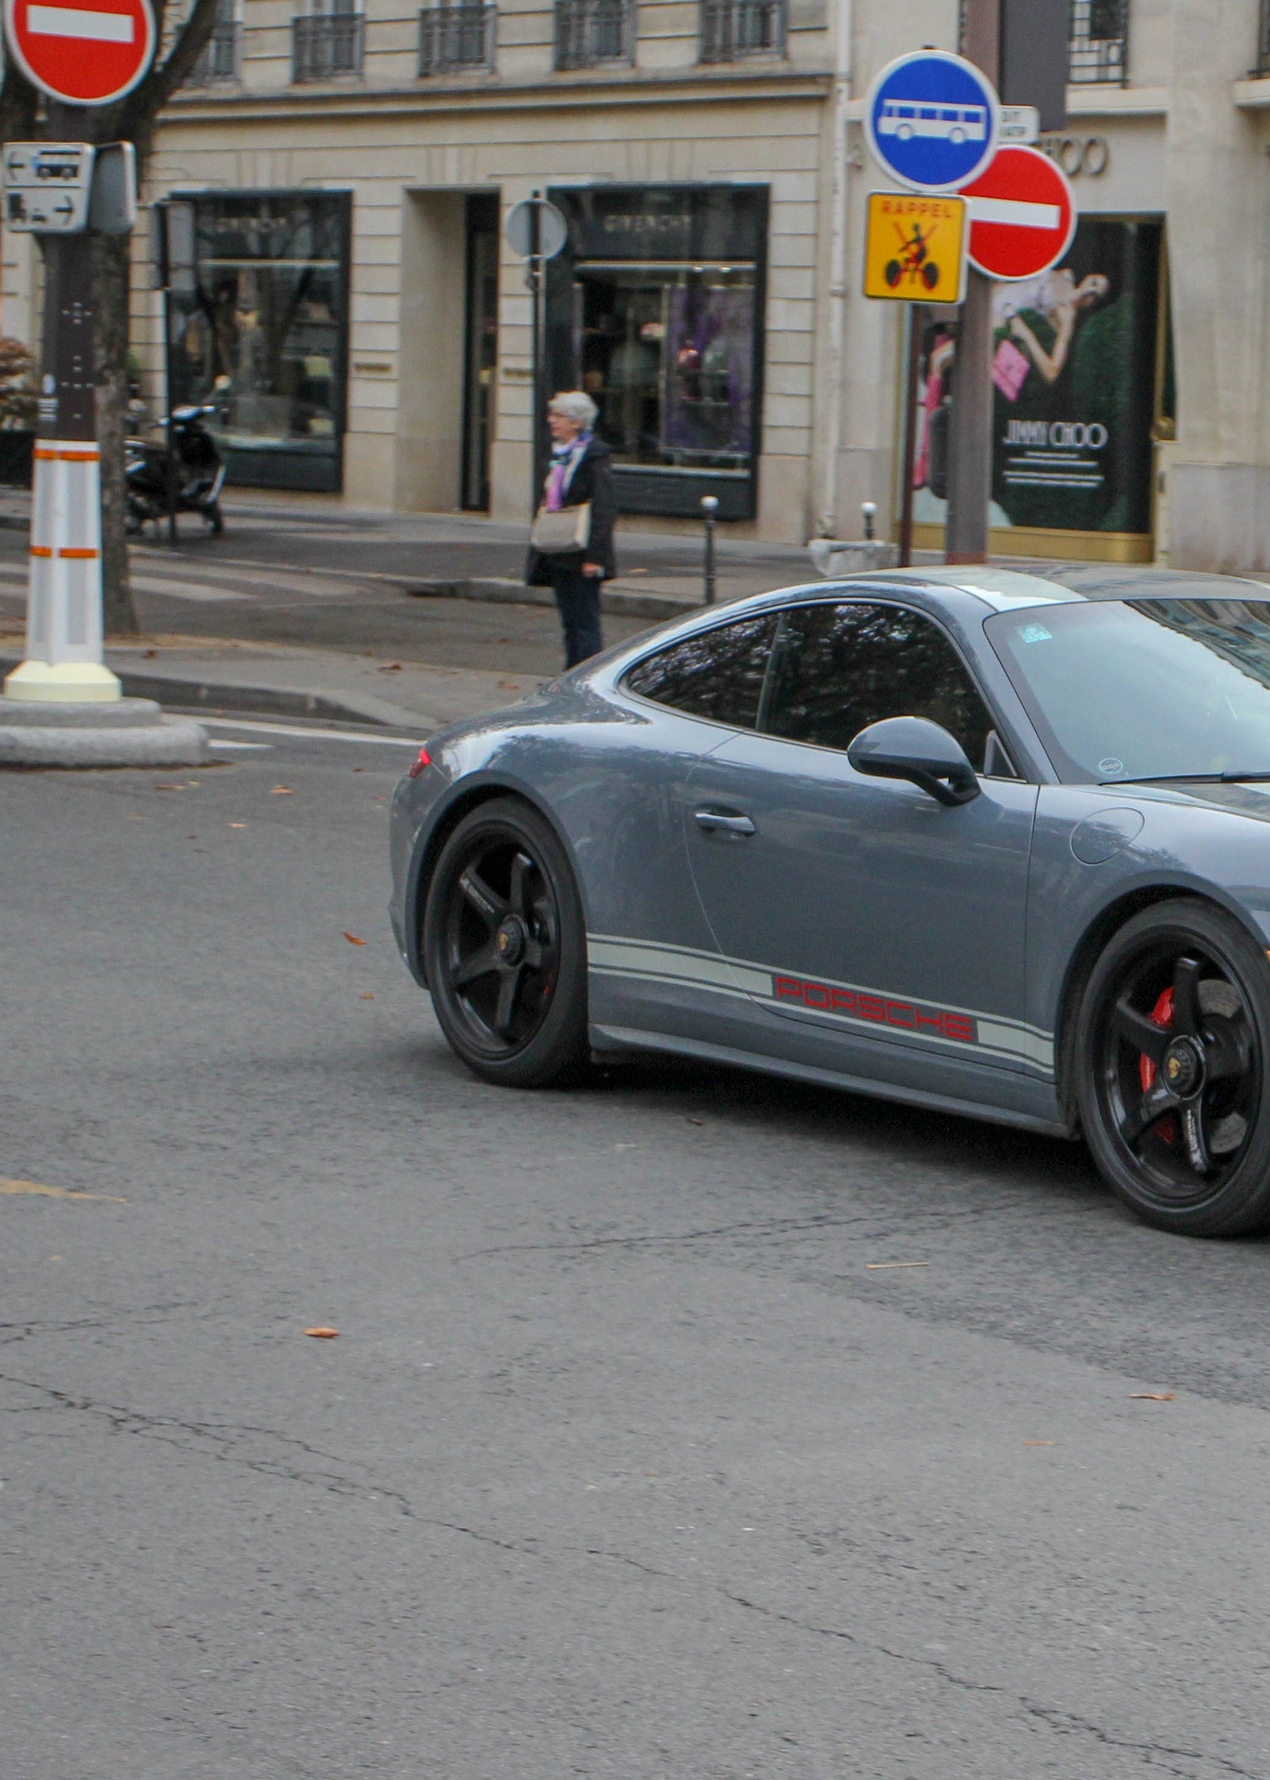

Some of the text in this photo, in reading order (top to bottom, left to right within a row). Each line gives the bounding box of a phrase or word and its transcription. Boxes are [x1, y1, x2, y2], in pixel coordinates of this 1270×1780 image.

[881, 200, 954, 218] RAPPEL
[1049, 421, 1109, 450] CHOO
[776, 976, 973, 1041] PORSCHE
